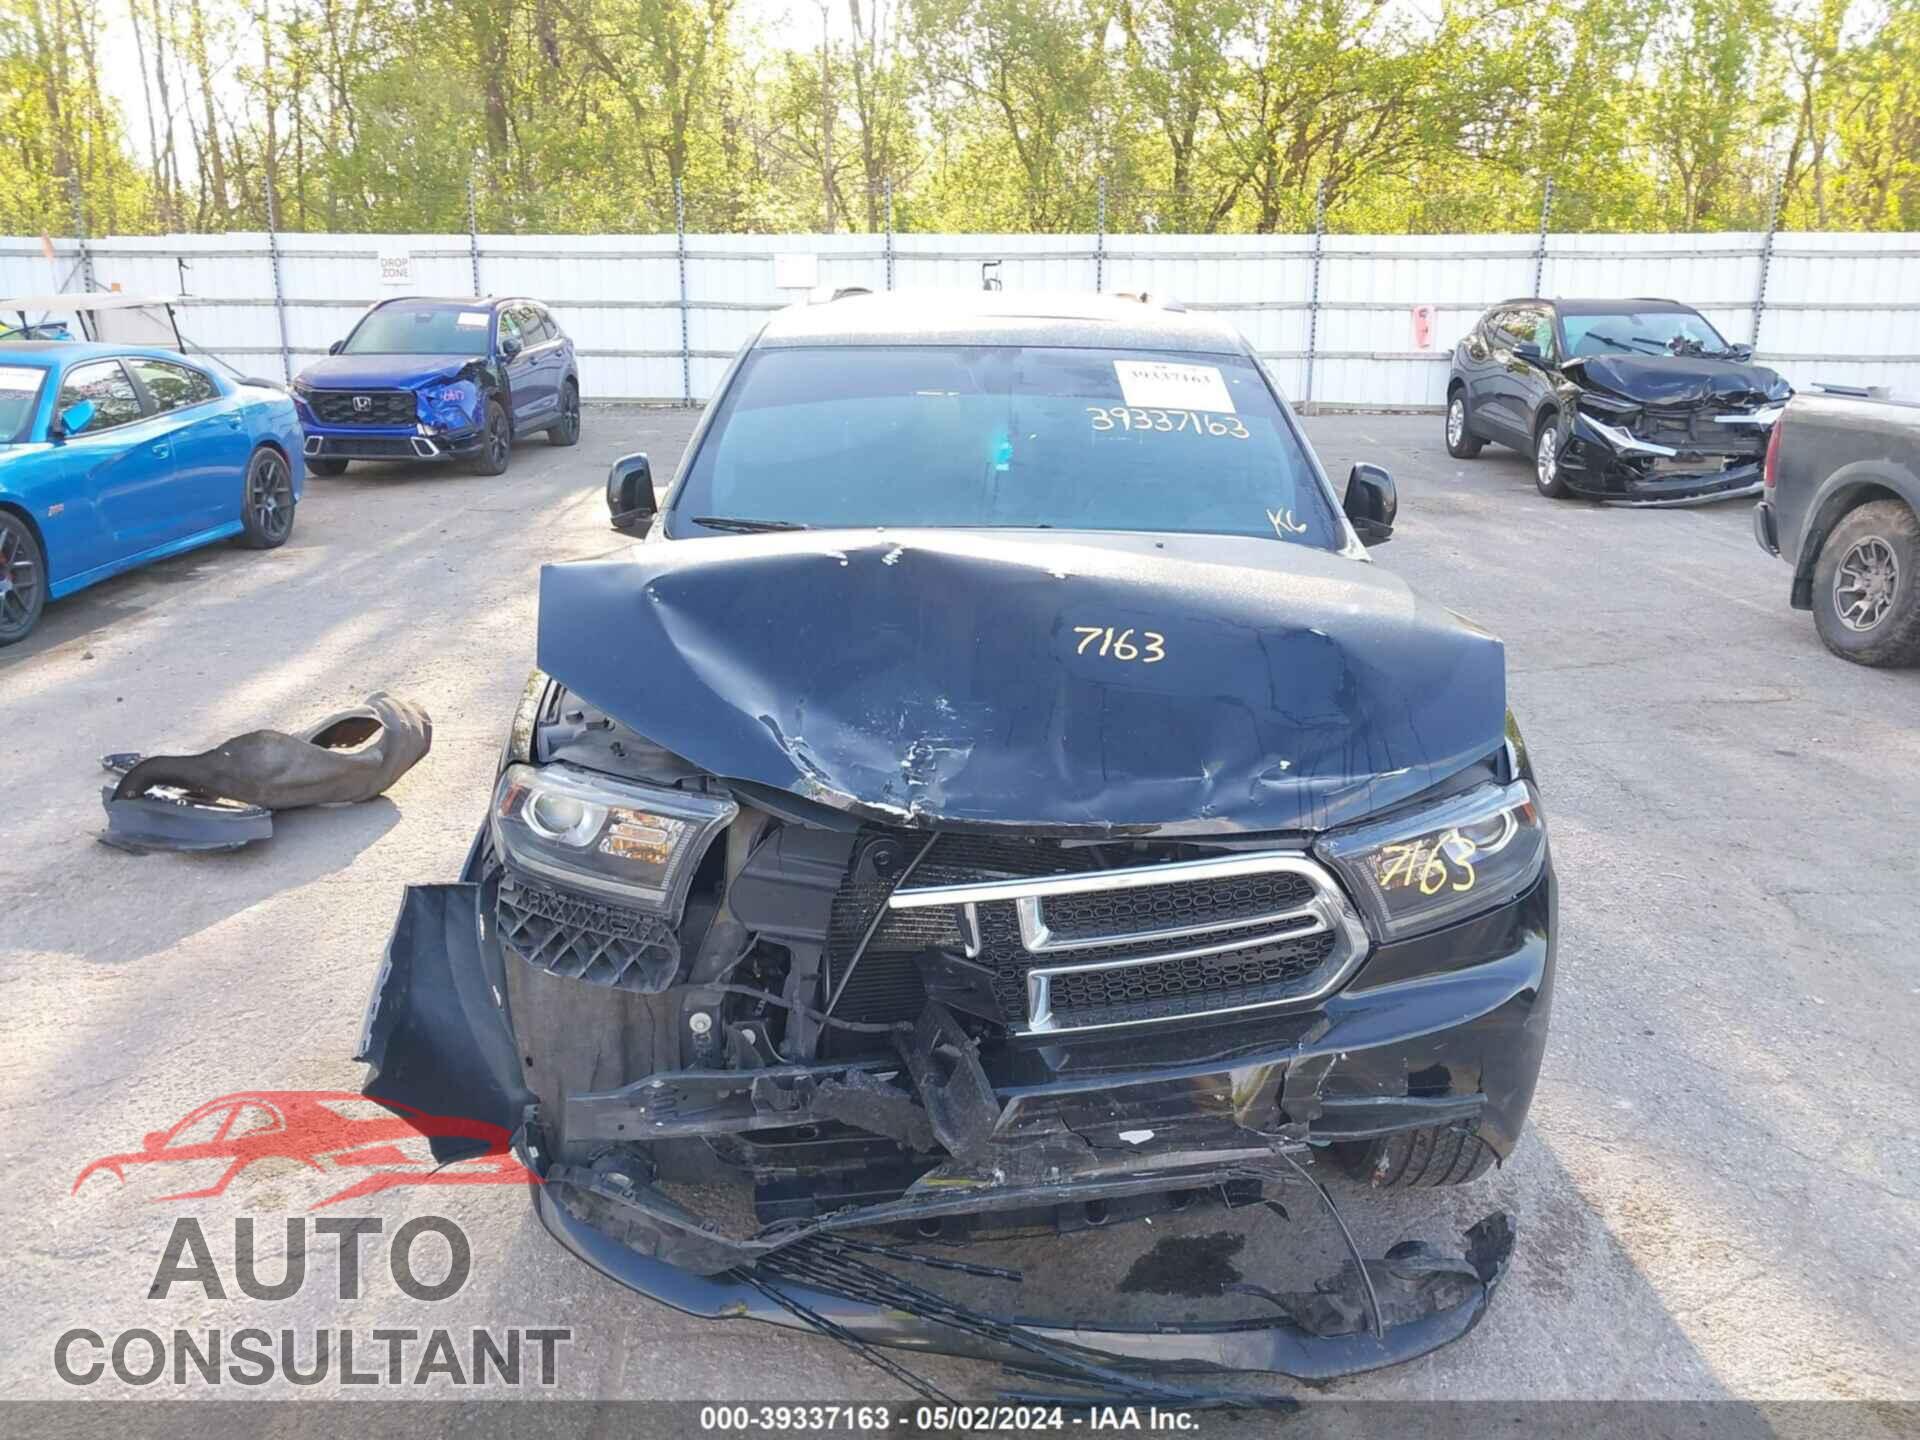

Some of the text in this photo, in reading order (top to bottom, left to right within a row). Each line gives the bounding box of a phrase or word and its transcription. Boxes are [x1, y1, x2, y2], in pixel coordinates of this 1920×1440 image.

[381, 258, 408, 267] DROP
[382, 268, 408, 278] ZONE
[1085, 407, 1250, 439] 39337163
[1073, 627, 1165, 662] 7163
[1380, 833, 1476, 895] 7163
